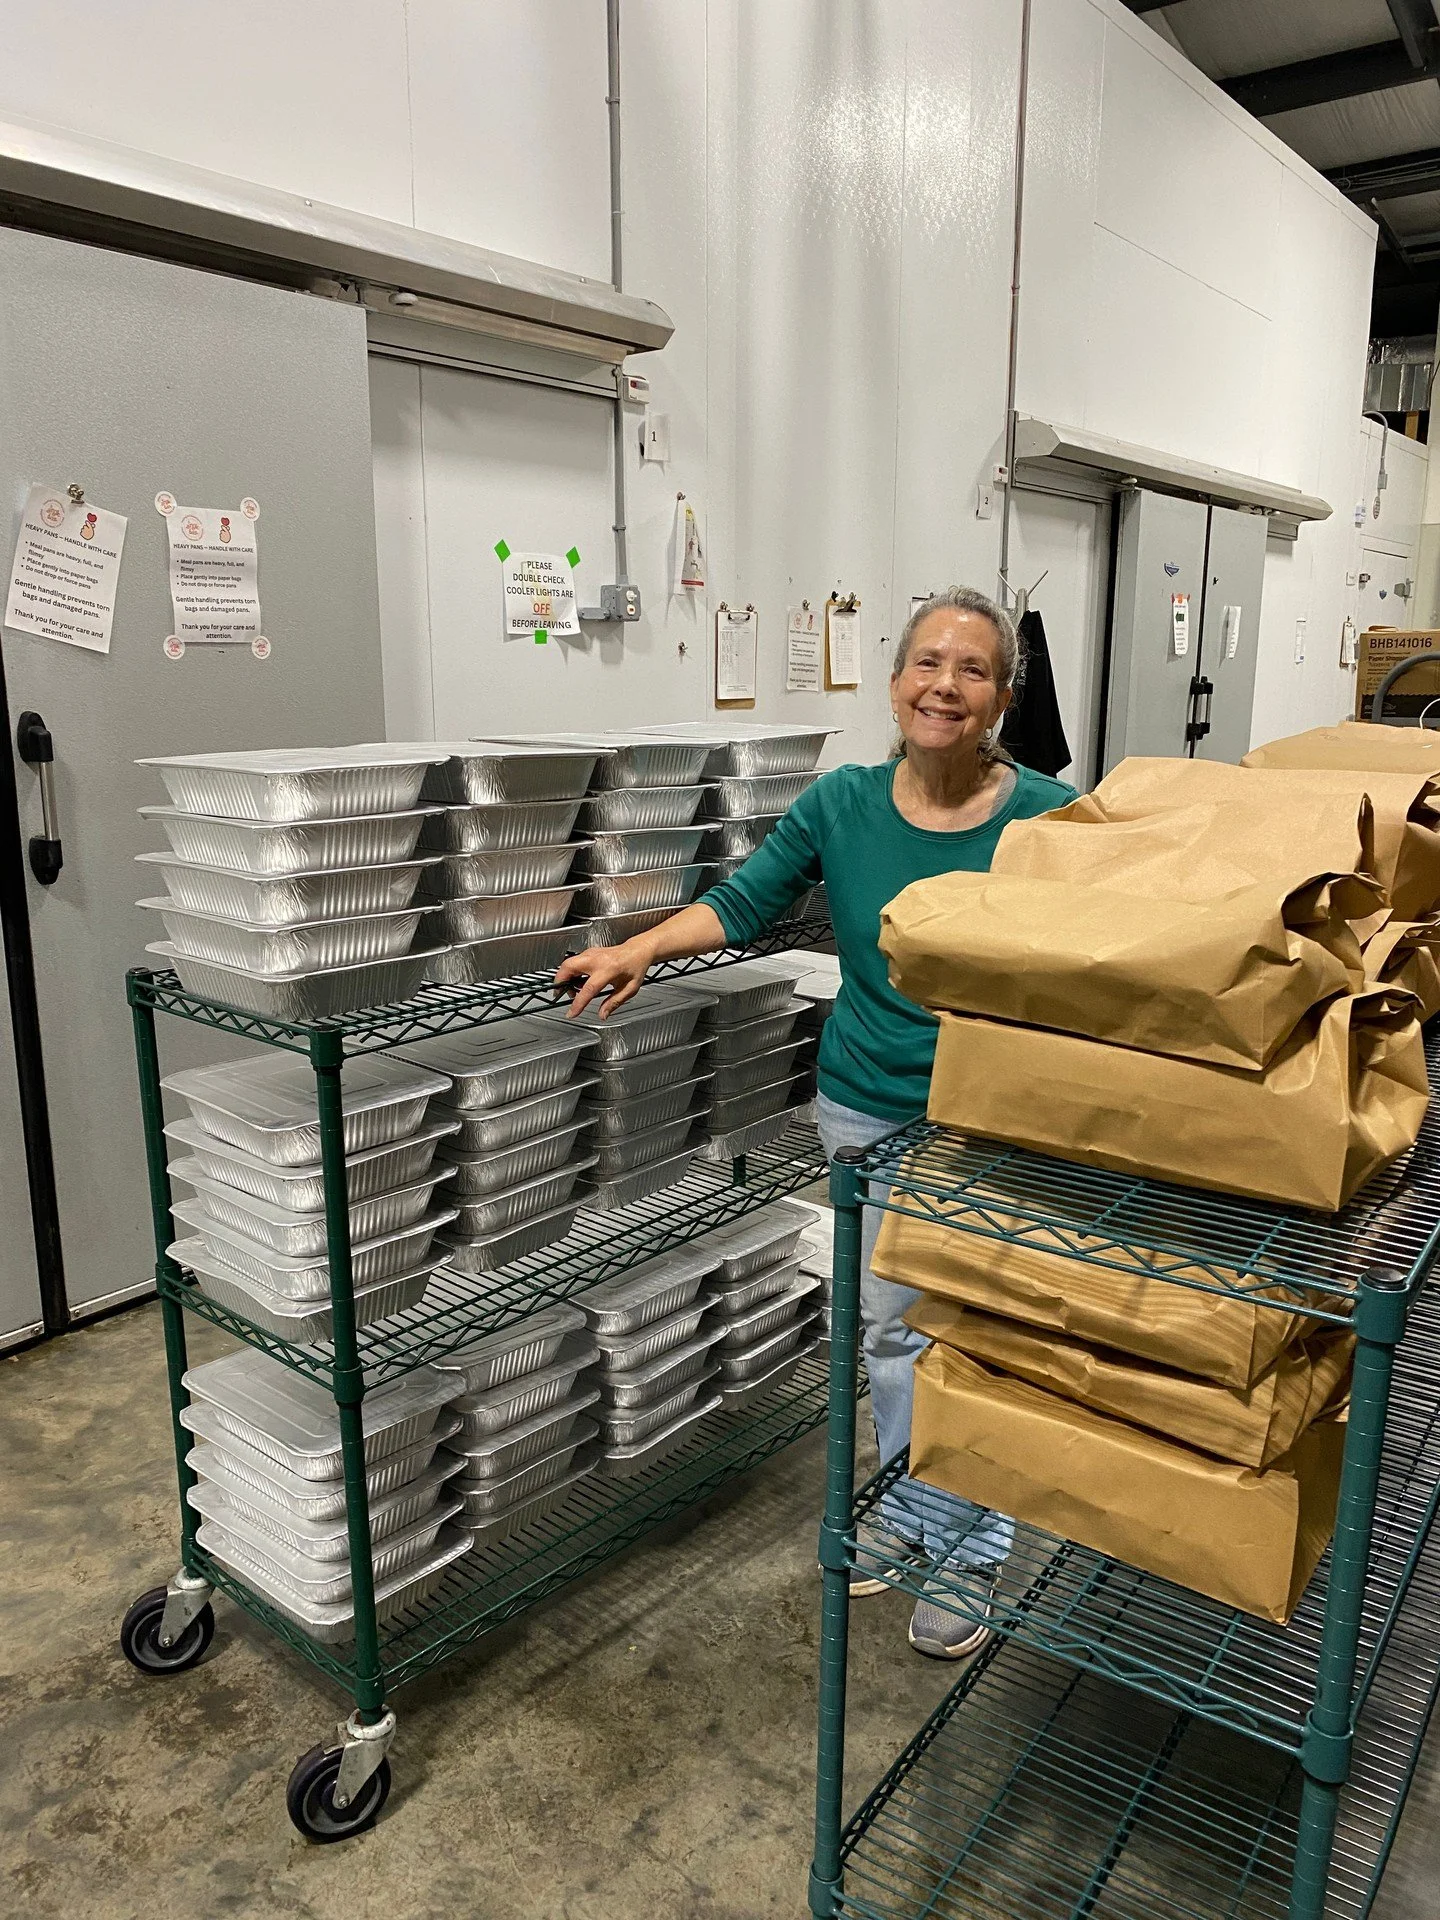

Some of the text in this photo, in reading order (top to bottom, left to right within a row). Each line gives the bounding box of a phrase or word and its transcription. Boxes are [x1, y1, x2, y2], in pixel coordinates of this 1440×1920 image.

[652, 431, 656, 442] 1
[984, 496, 989, 505] 2
[25, 523, 43, 534] HEAVY
[44, 529, 58, 539] PANS
[65, 537, 87, 548] HANDLE
[88, 544, 102, 553] WITH
[103, 549, 116, 558] CARE
[43, 546, 56, 555] pans
[66, 553, 82, 564] heavy,
[83, 559, 92, 567] full,
[27, 556, 99, 584] Place gently into paper bags
[527, 561, 552, 570] PLEASE
[44, 570, 56, 579] drop
[64, 577, 78, 585] force
[513, 573, 565, 584] DOUBLE CHECK
[15, 579, 110, 612] Gentle handling prevents torn
[507, 586, 573, 598] COOLER LIGHTS ARE
[22, 591, 100, 619] bags and damaged pans.
[533, 603, 550, 613] OFF
[15, 609, 34, 619] Thank
[35, 615, 47, 623] you
[59, 622, 75, 631] your
[76, 627, 90, 635] care
[91, 630, 104, 638] and
[512, 619, 571, 629] BEFORE LEAVING
[42, 628, 74, 640] attention.
[1370, 637, 1432, 648] BHB141016
